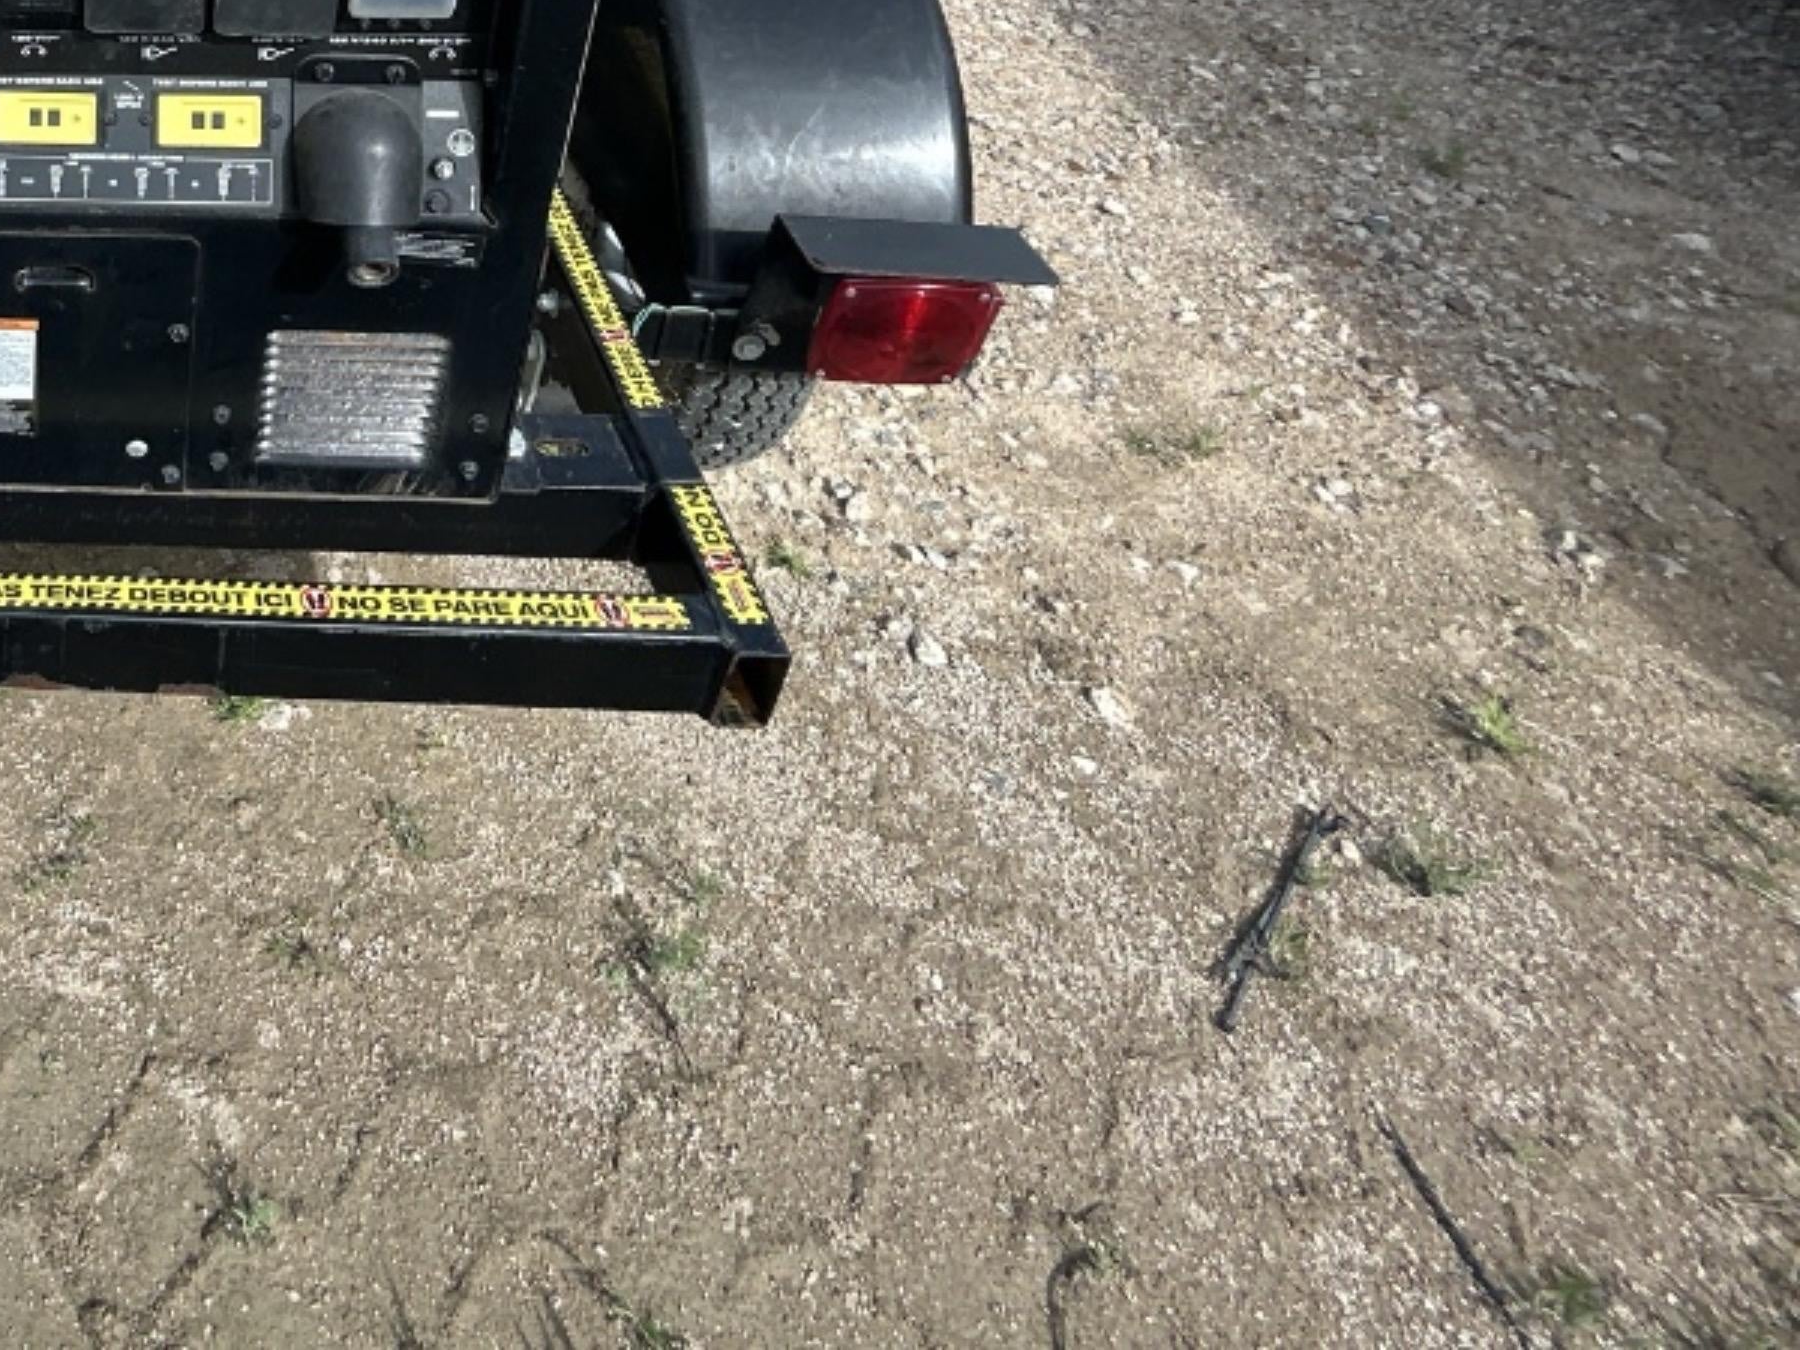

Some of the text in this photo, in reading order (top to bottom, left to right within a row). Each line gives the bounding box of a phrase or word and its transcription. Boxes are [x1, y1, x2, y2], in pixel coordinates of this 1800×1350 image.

[30, 584, 122, 602] TENEZ
[128, 587, 252, 607] DEBOUT
[255, 592, 293, 607] ICI
[337, 594, 381, 612] NO
[387, 596, 425, 613] SE
[432, 598, 512, 616] PARE
